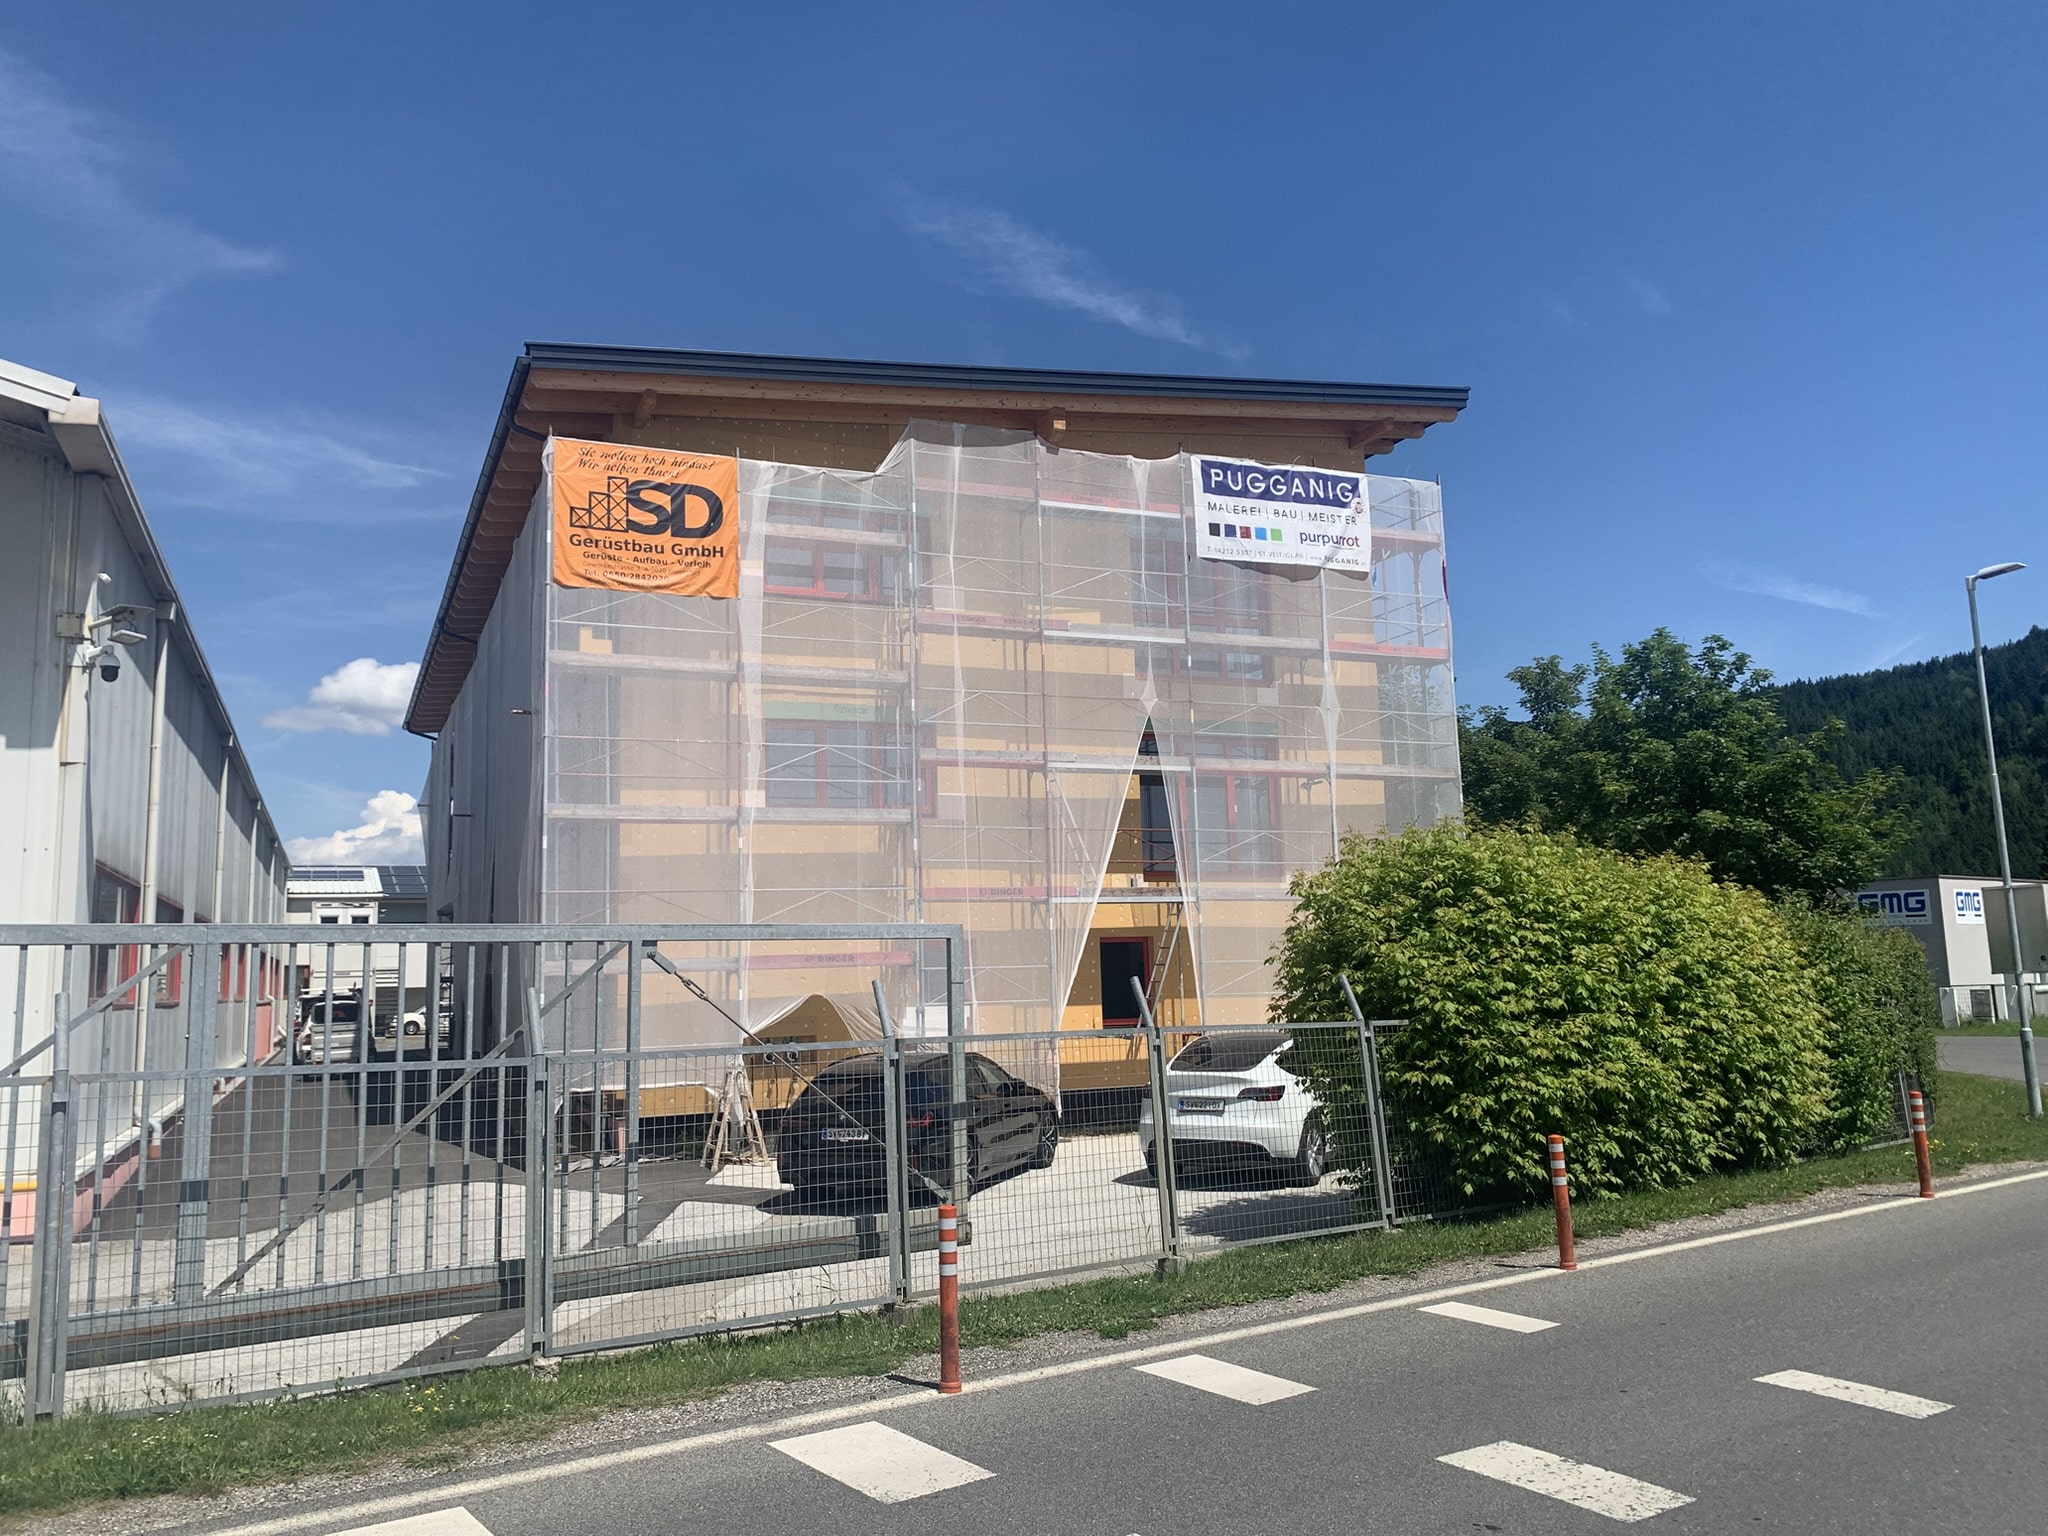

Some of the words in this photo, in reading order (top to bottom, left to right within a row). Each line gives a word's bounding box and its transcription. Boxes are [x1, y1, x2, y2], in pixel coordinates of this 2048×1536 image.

[577, 447, 593, 459] Sie
[601, 449, 637, 463] wollen
[642, 454, 667, 466] hoch
[671, 456, 716, 470] hinaus?
[577, 459, 600, 471] Wir
[603, 461, 638, 475] helfen
[643, 466, 680, 478] Ihnen!
[1210, 468, 1353, 503] PUGGANIG
[1207, 501, 1262, 517] MALEREI
[1273, 509, 1298, 519] BAU
[1308, 512, 1358, 526] MEISTER
[569, 533, 665, 555] Gerüstbau
[670, 543, 725, 558] GmbH
[1299, 530, 1361, 548] purpurrot
[582, 551, 623, 562] Gerüste
[632, 555, 668, 566] Aufbau
[677, 559, 712, 569] Verleih
[583, 569, 600, 577] Tel.
[1955, 891, 1982, 912] GMG
